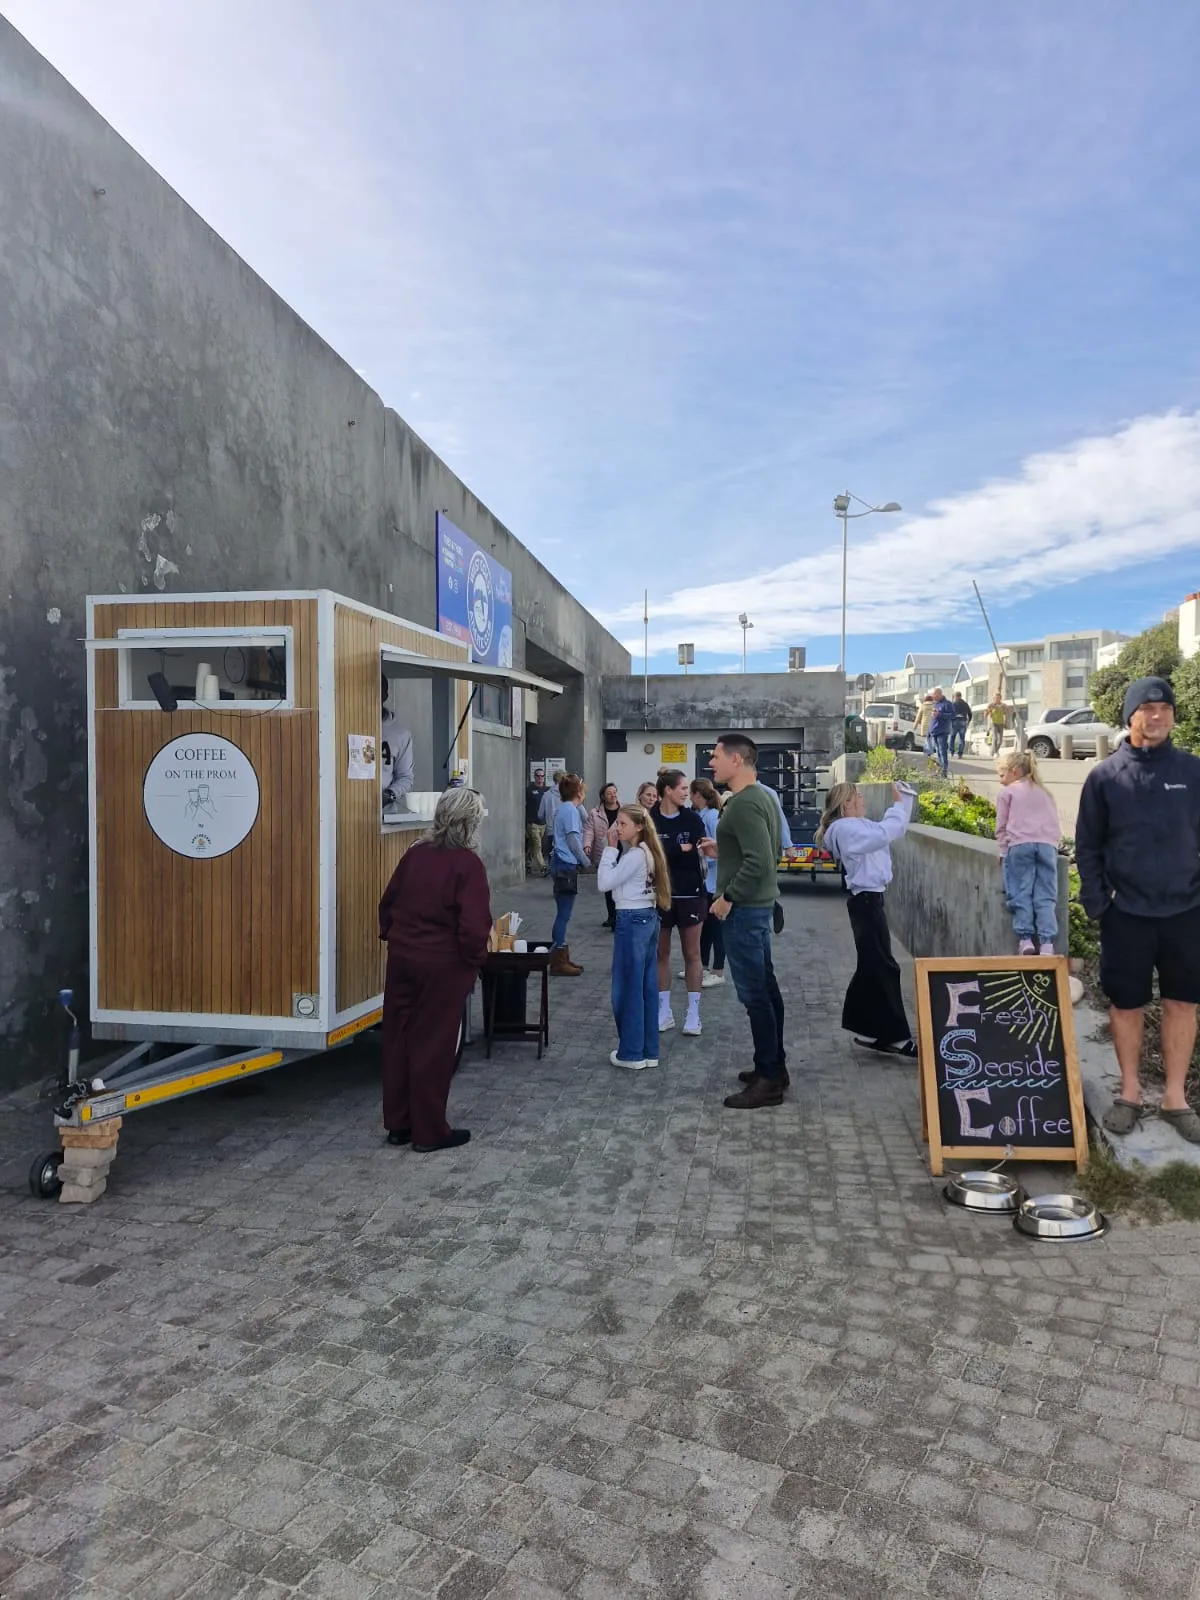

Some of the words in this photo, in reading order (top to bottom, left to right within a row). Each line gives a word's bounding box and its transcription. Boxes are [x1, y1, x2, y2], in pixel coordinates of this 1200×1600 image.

[164, 769, 180, 779] ON
[183, 769, 205, 779] THE
[207, 769, 237, 779] PROM
[174, 748, 227, 761] COFFEE
[945, 980, 1049, 1027] Fresh
[939, 1028, 1062, 1081] Seaside
[954, 1087, 1072, 1139] Coffee
